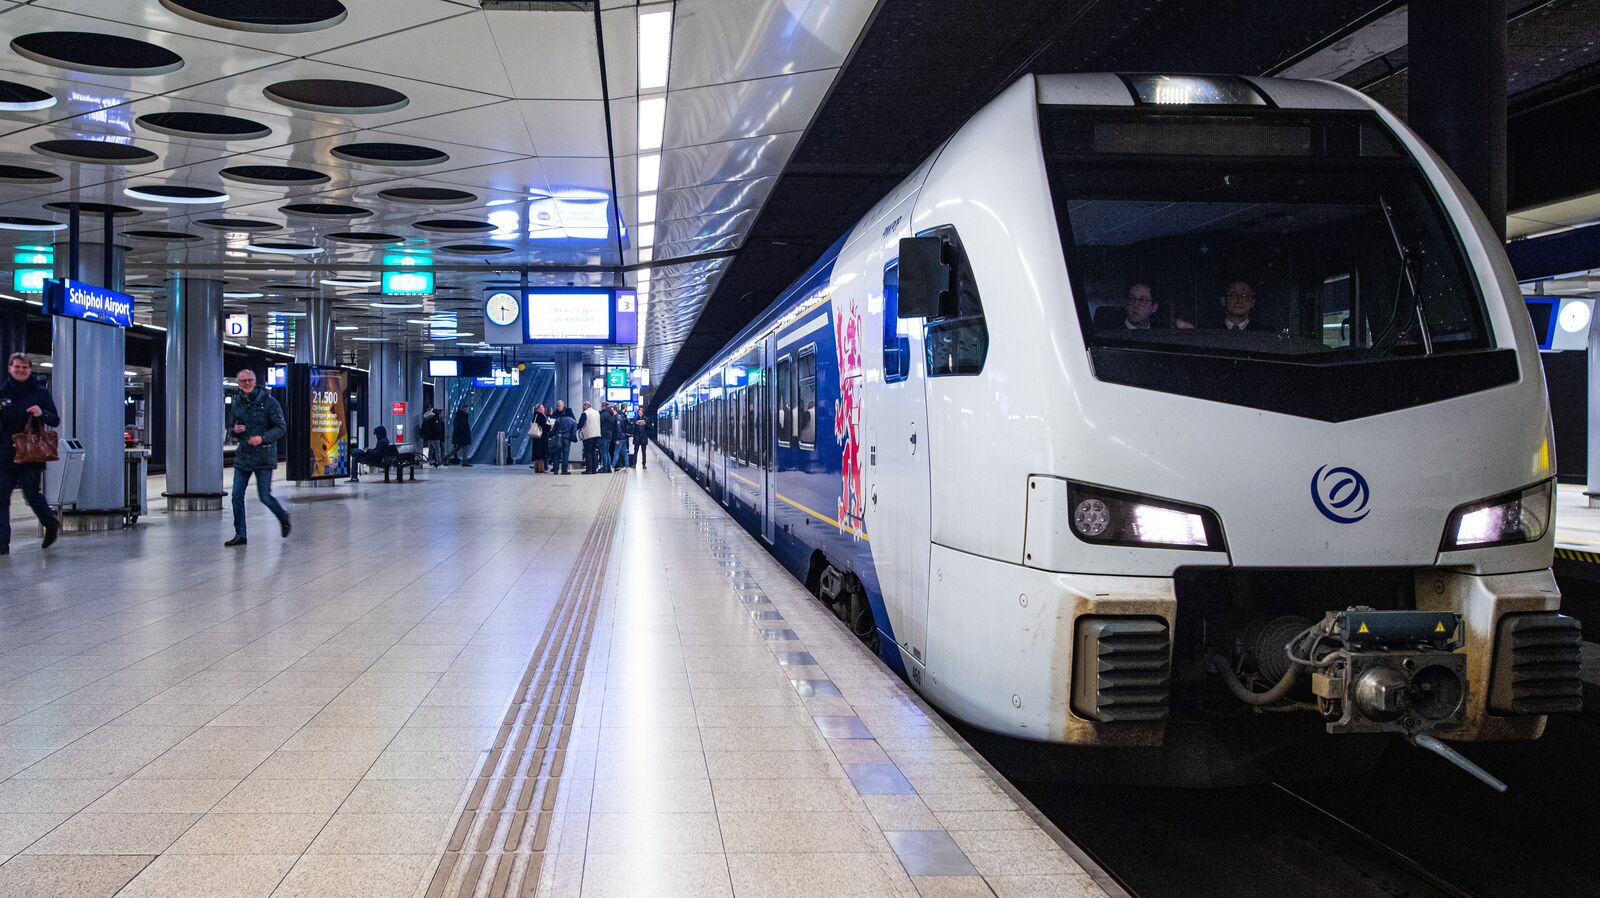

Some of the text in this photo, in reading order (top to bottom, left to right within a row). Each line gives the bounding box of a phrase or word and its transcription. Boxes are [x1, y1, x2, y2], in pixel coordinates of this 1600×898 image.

[69, 287, 130, 317] Schiphol Airport
[231, 322, 242, 335] D
[312, 391, 338, 404] 21.500
